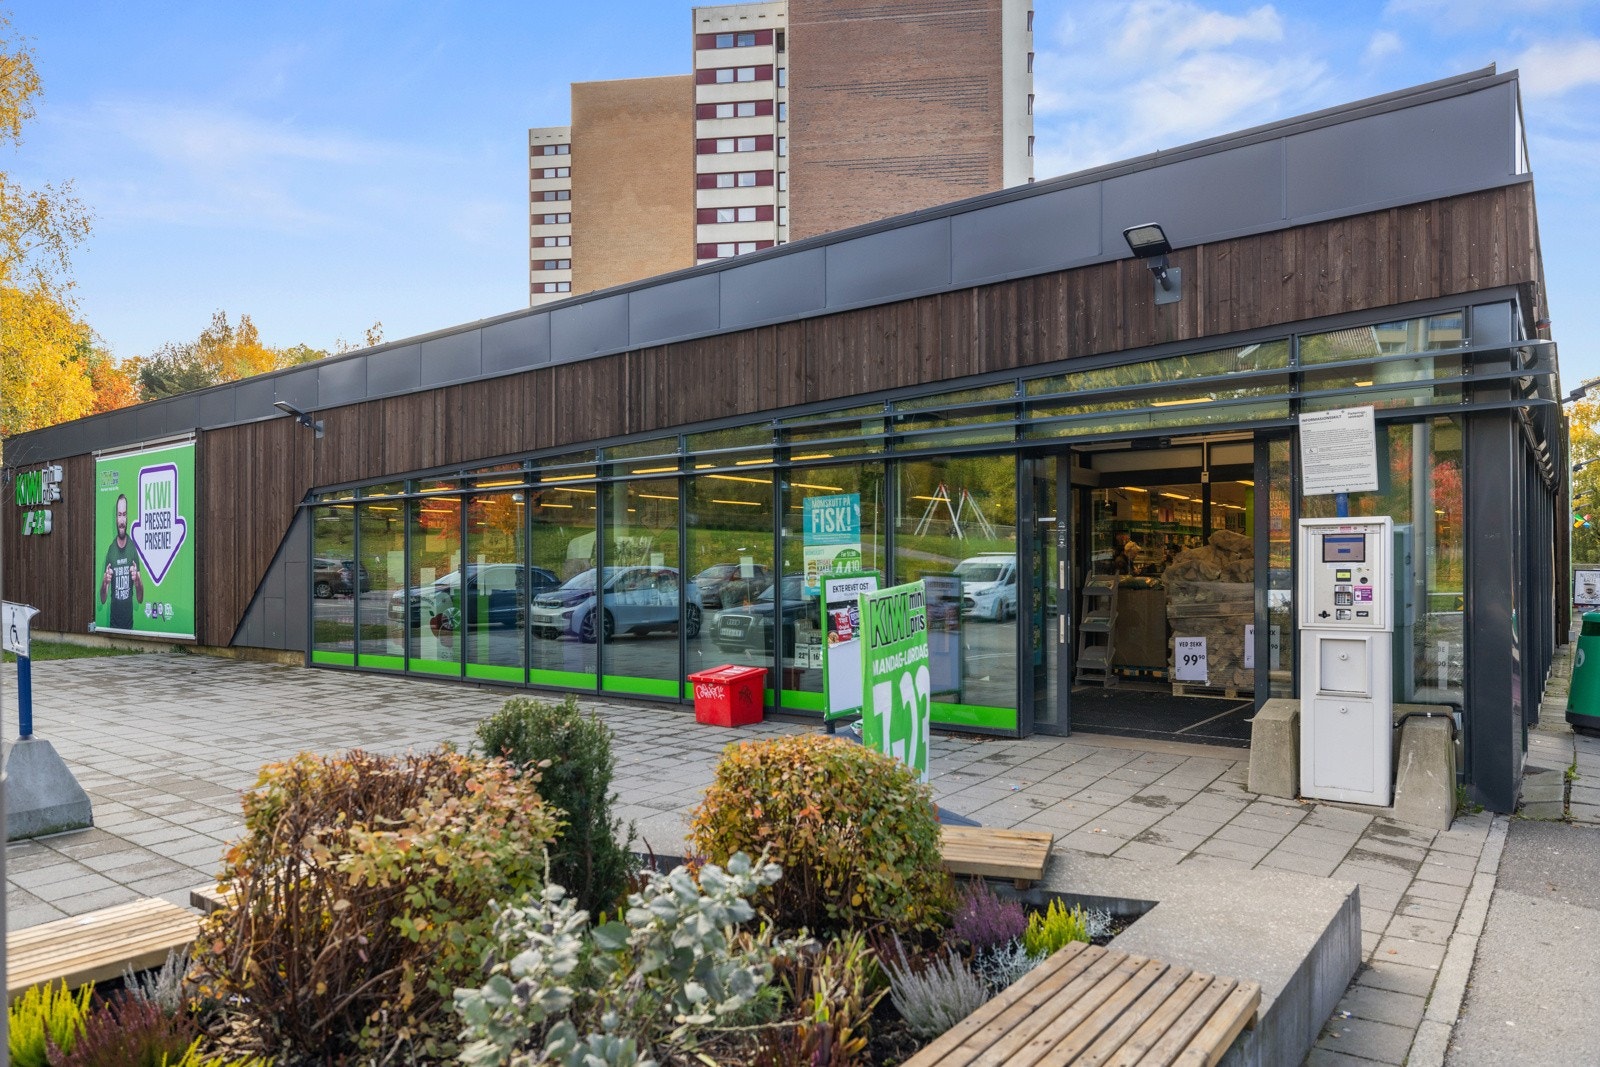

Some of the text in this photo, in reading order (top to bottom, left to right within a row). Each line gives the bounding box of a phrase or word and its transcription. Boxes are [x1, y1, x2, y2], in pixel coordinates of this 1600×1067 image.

[15, 469, 43, 506] KIWI
[145, 481, 171, 510] KIWI
[145, 511, 171, 530] PRESSER
[812, 507, 852, 534] FISK!
[145, 531, 171, 550] PRISENE!
[832, 582, 869, 594] EKTE REVET OST
[909, 587, 925, 610] mini
[870, 592, 909, 648] KIWI
[910, 613, 926, 639] pris
[873, 644, 929, 677] MANDAG-LØRDAG
[1183, 654, 1198, 666] 99
